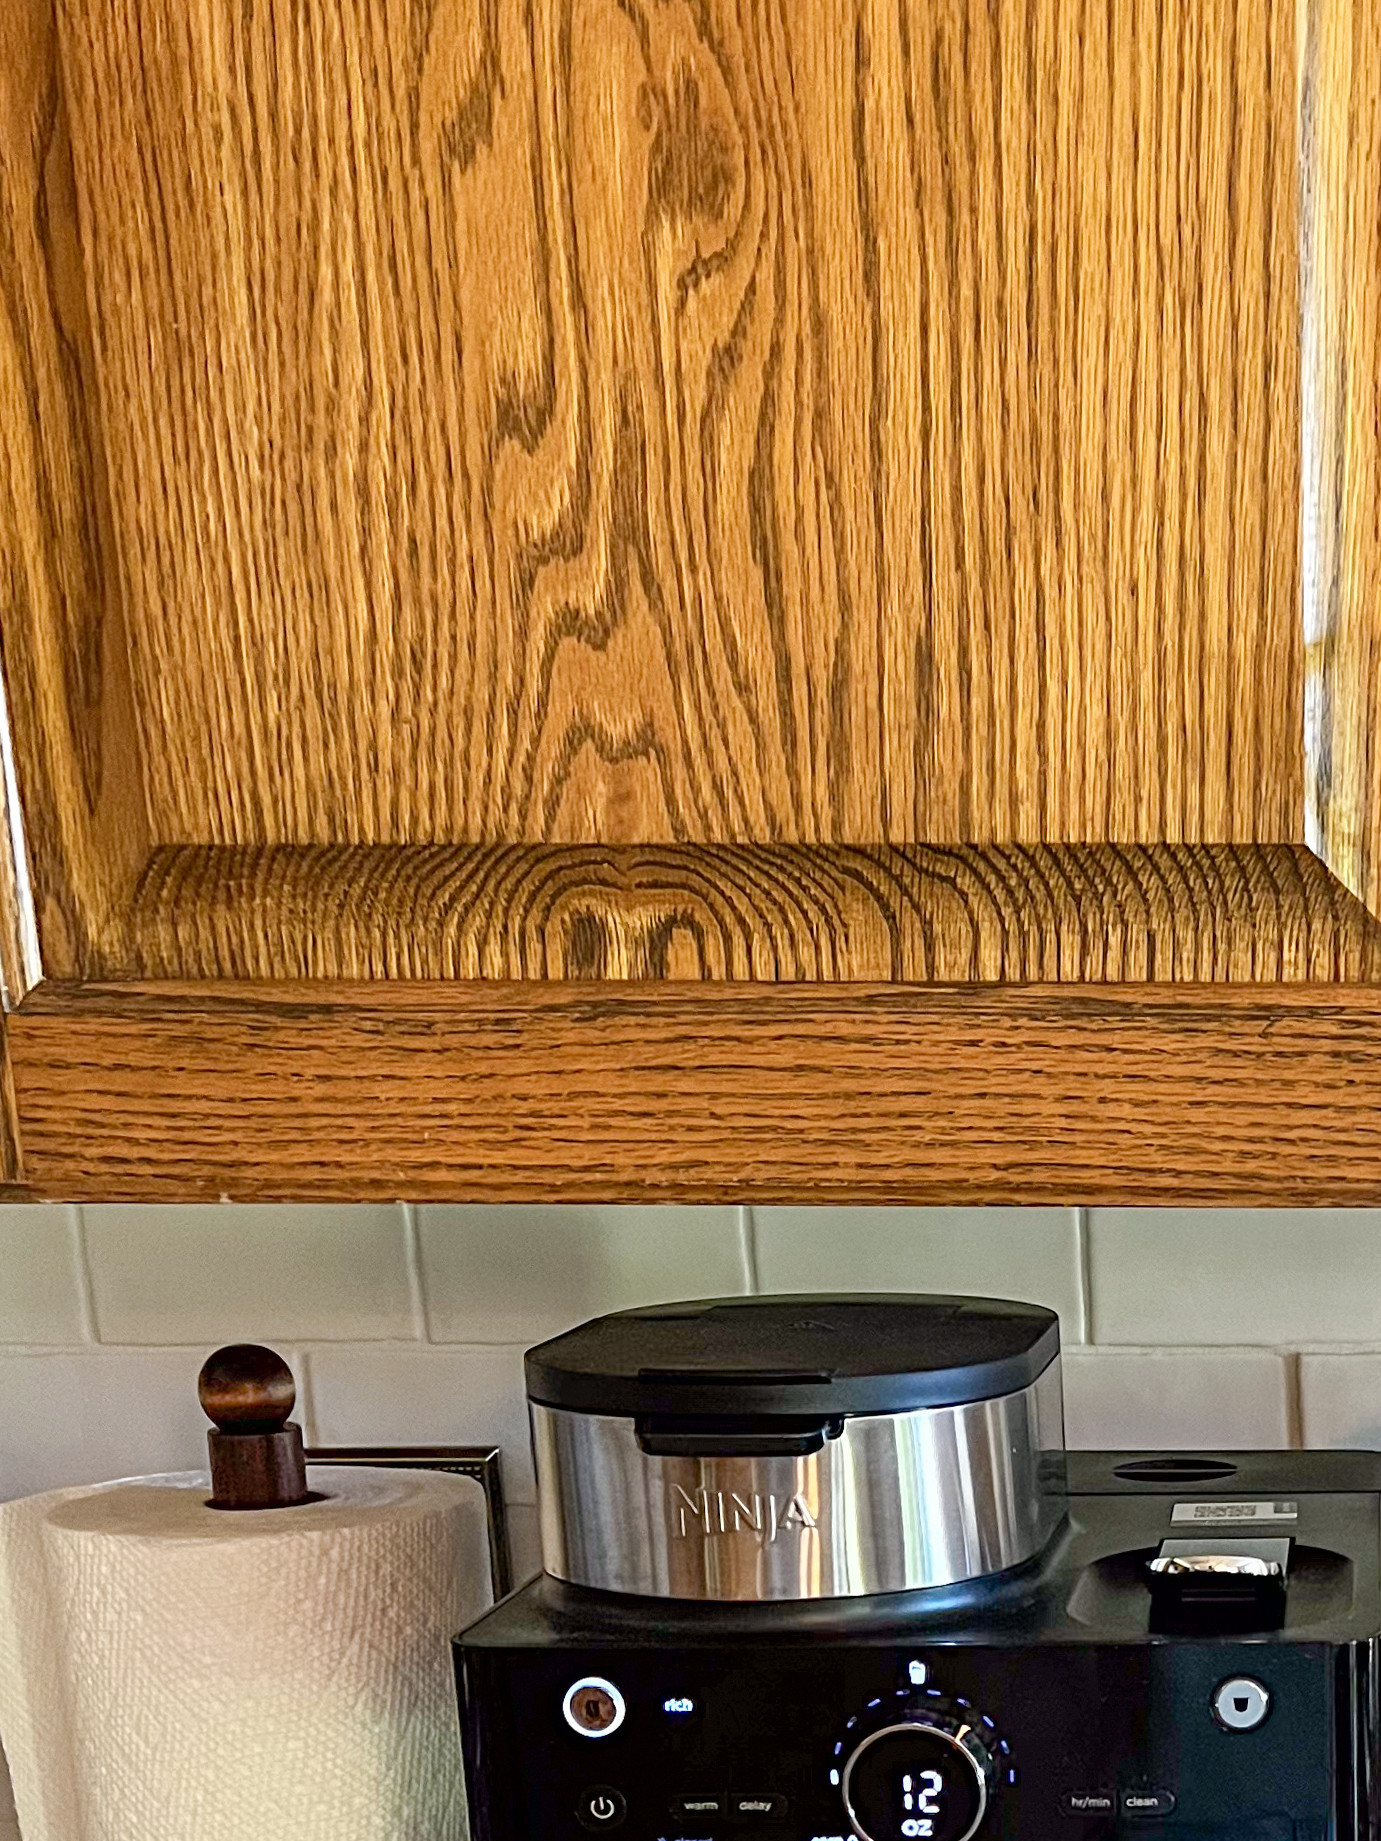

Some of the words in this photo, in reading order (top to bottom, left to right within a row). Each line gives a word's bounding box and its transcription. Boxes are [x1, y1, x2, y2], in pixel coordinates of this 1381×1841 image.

[670, 1483, 816, 1542] NINJA
[663, 1697, 694, 1712] rich
[901, 1769, 943, 1814] 12
[683, 1801, 719, 1811] warm
[738, 1800, 773, 1813] delay
[1071, 1796, 1112, 1809] hr/min
[1125, 1796, 1159, 1807] clean
